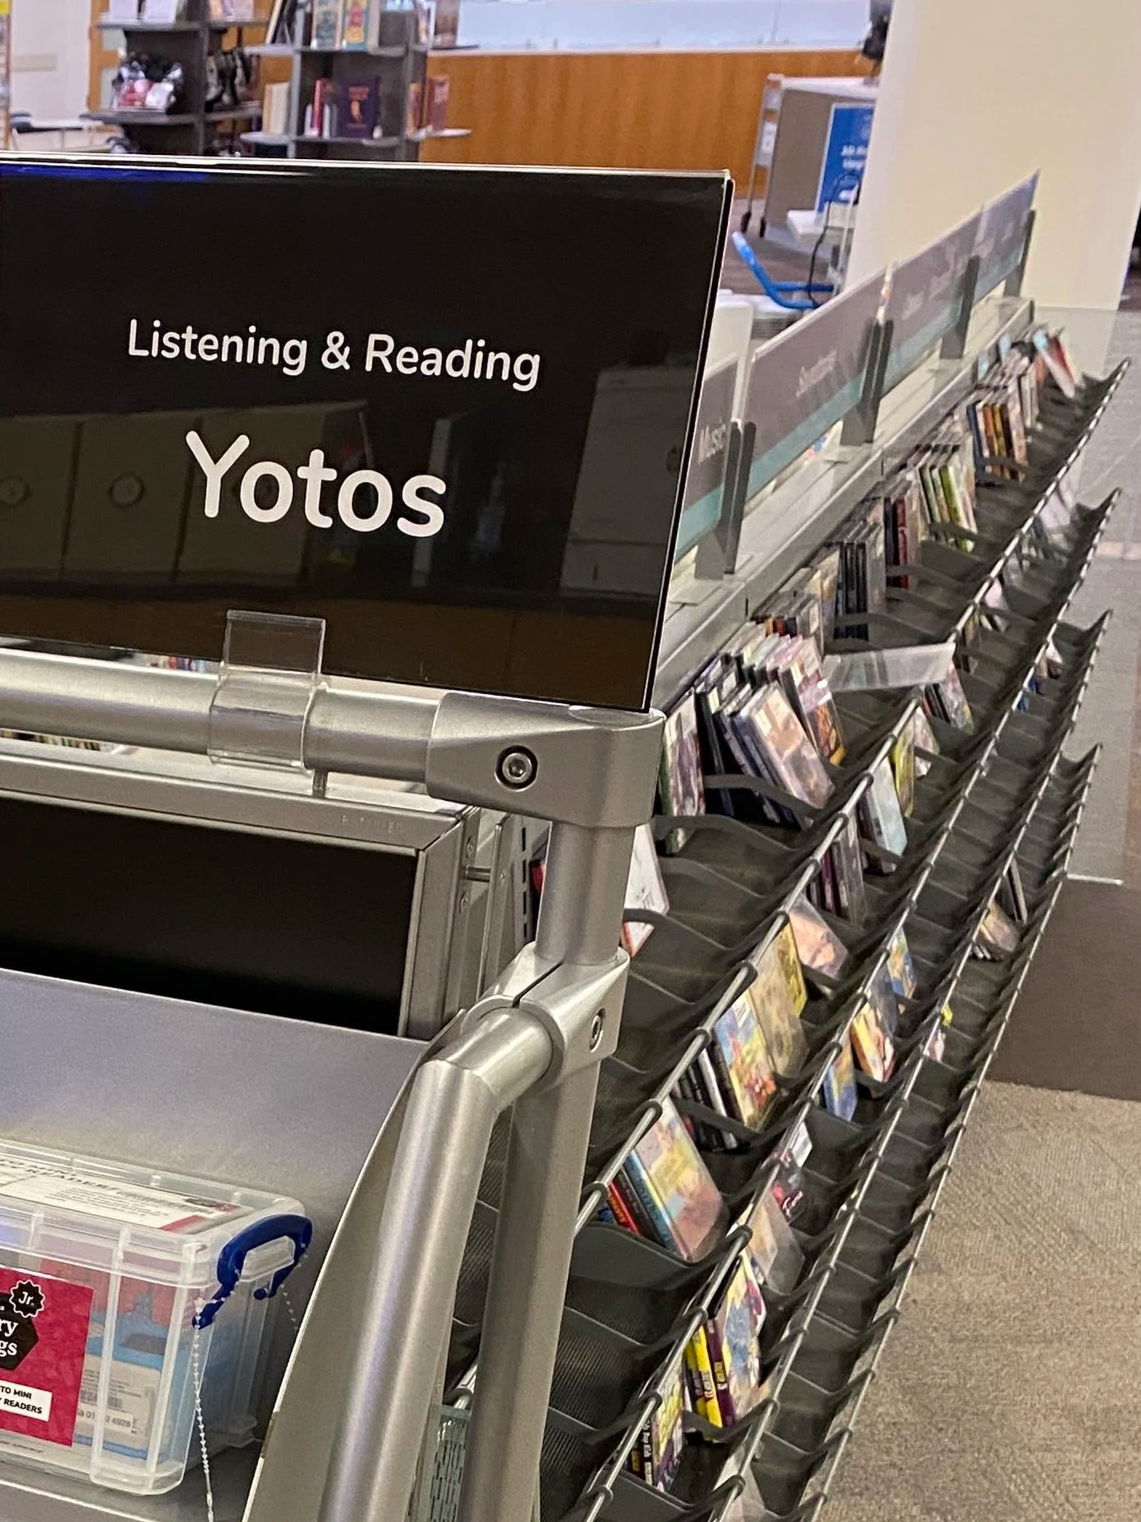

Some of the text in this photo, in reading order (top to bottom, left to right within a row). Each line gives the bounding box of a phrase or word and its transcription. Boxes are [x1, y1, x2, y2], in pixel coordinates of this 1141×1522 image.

[128, 318, 541, 392] Listening & Reading
[186, 430, 447, 537] Yotos
[18, 1291, 35, 1306] Jr.
[14, 1389, 32, 1400] MINI
[4, 1398, 43, 1414] READERS
